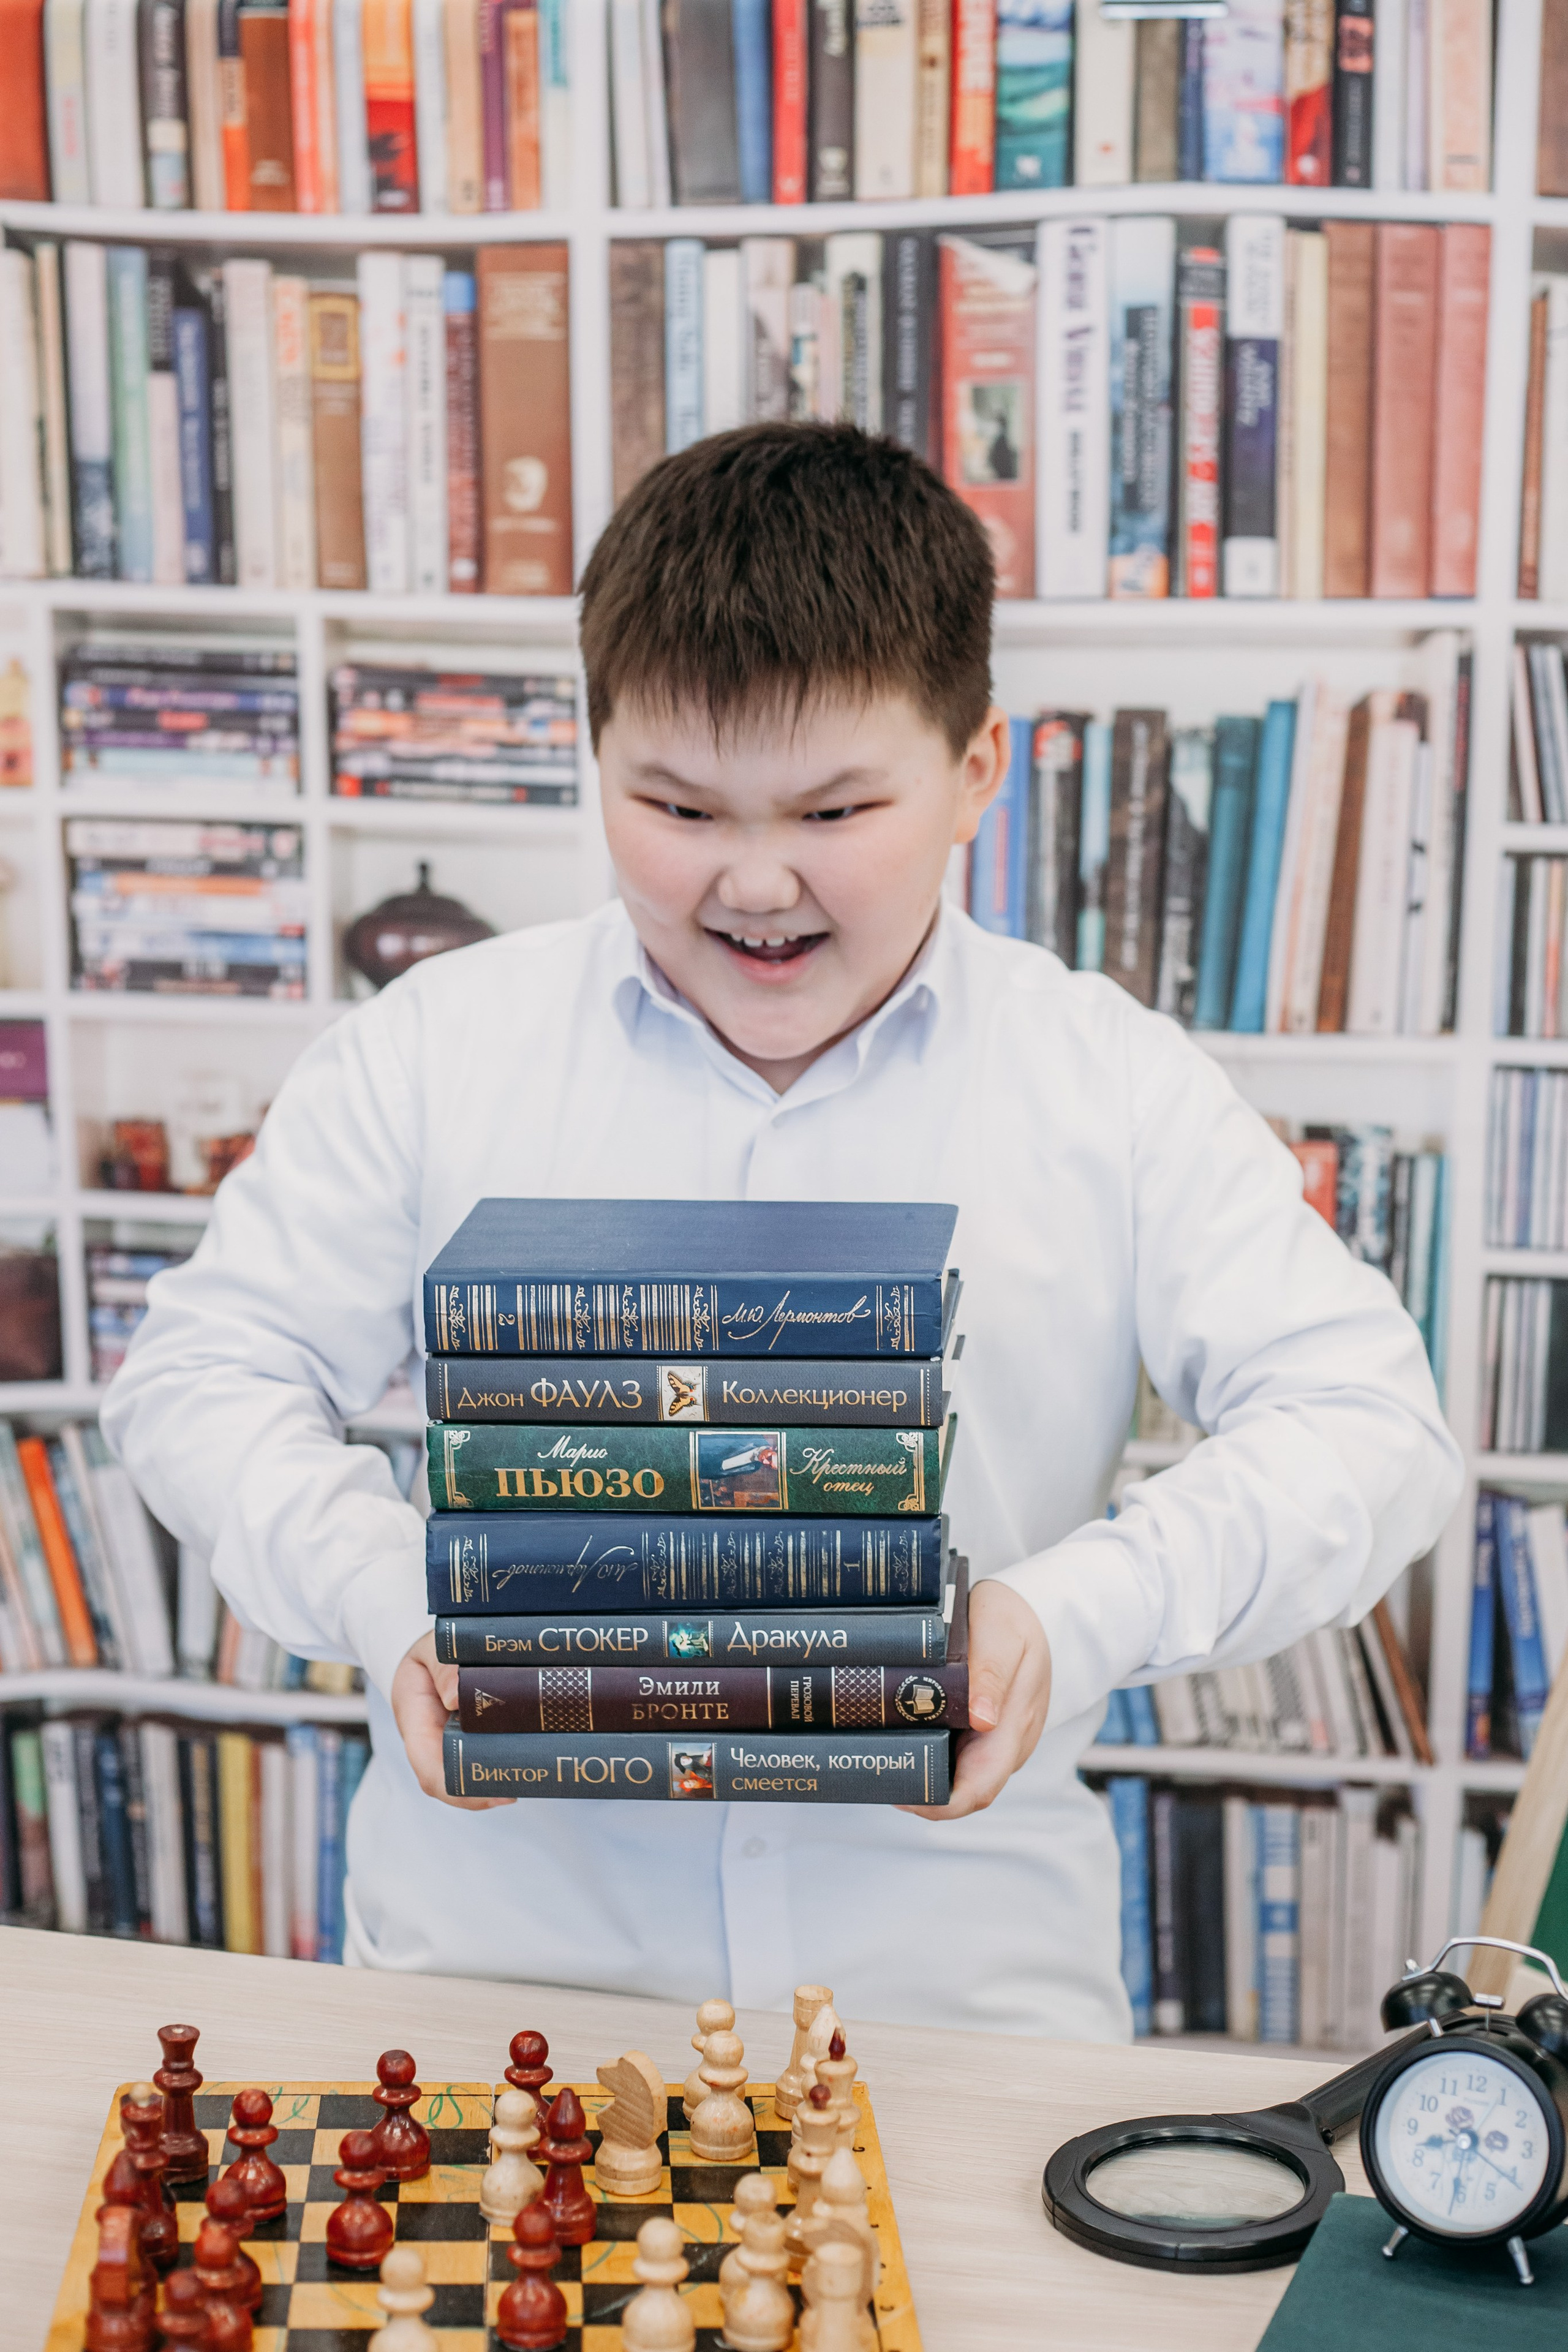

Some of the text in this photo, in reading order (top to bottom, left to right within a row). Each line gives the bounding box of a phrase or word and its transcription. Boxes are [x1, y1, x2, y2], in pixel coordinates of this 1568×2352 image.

[498, 1313, 514, 1326] 2
[728, 1291, 872, 1350] Лермонтов
[458, 1378, 642, 1409] Джон ФАУЛЗ
[722, 1381, 907, 1412] Коллекционер
[538, 1435, 608, 1468] Марио
[790, 1447, 907, 1483] Крестный
[494, 1468, 665, 1498] ПЬЮЗО
[824, 1481, 875, 1496] отец
[484, 1627, 649, 1651] Брэм СТОКЕР
[728, 1621, 848, 1658] Дракула
[639, 1676, 720, 1696] Эмили
[790, 1681, 800, 1719] ПЕРЕВАЛ
[803, 1676, 814, 1722] ГРОЗОВОЙ
[632, 1703, 729, 1720] БРОНТЕ
[472, 1756, 653, 1784] Виктор ГЮГО
[730, 1747, 915, 1775] Человек, который
[731, 1777, 817, 1791] смеется
[1439, 2078, 1458, 2097] 11
[1466, 2074, 1488, 2094] 12
[1419, 2094, 1439, 2113] 10
[1498, 2088, 1507, 2106] 1
[1407, 2118, 1419, 2136] 9
[1515, 2110, 1528, 2129] 2
[1412, 2149, 1425, 2168] 8
[1521, 2140, 1534, 2160] 3
[1430, 2171, 1441, 2190] 7
[1484, 2182, 1496, 2201] 5
